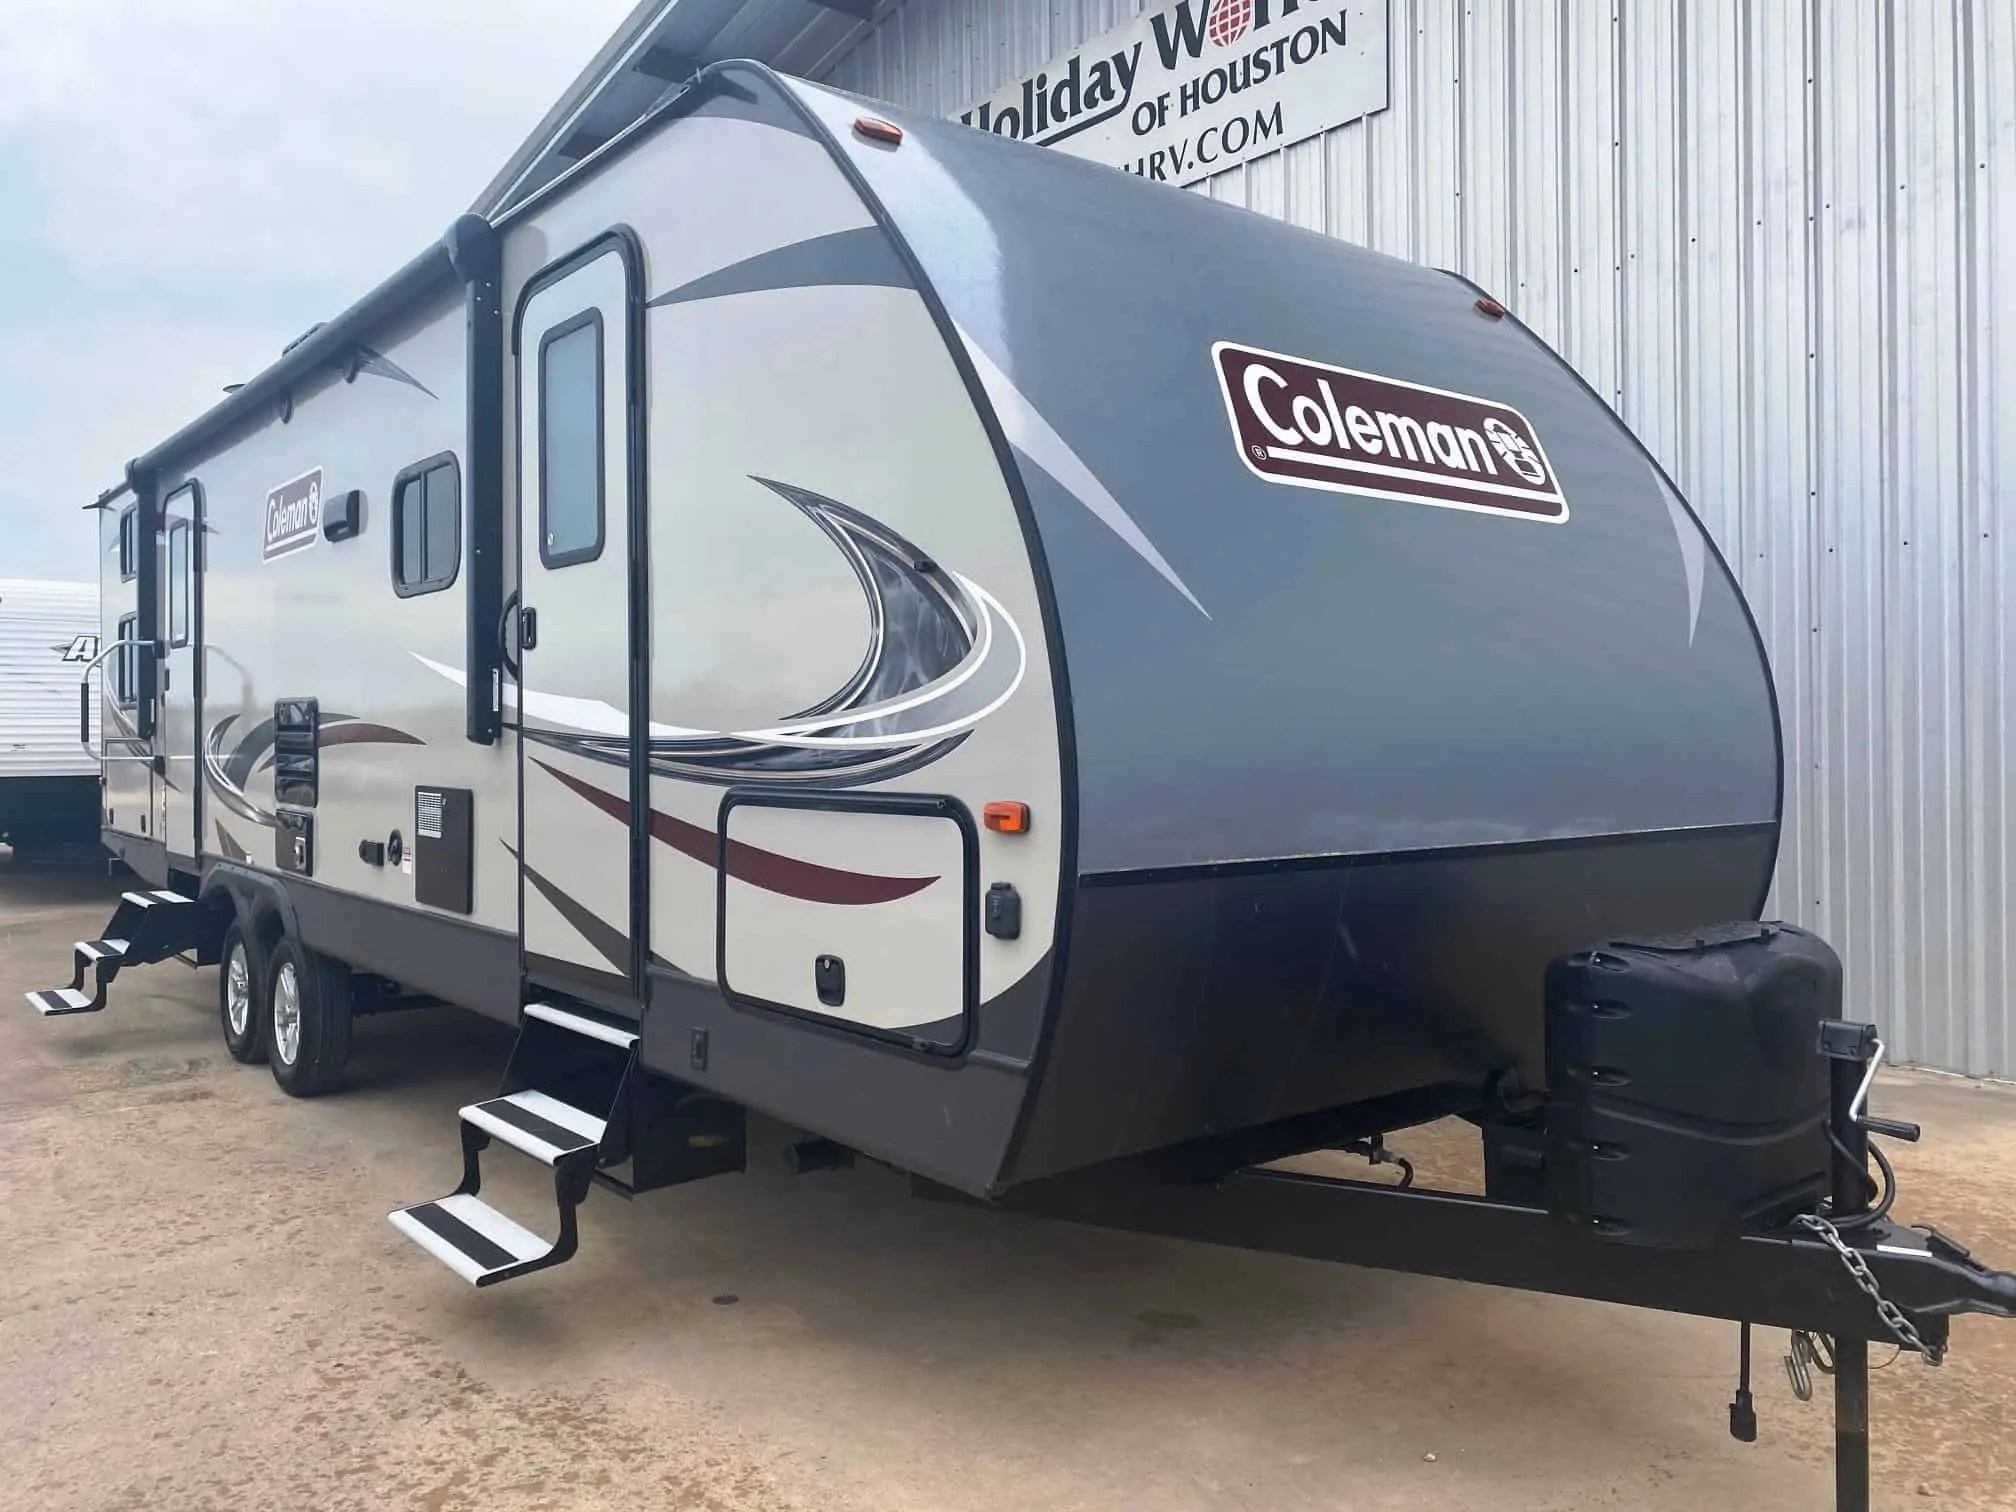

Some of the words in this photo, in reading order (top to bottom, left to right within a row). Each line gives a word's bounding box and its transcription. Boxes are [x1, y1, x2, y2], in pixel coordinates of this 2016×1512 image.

[1132, 93, 1170, 136] OF
[1180, 9, 1347, 119] HOUSTON
[1243, 363, 1498, 475] Coleman
[266, 495, 309, 543] Coleman
